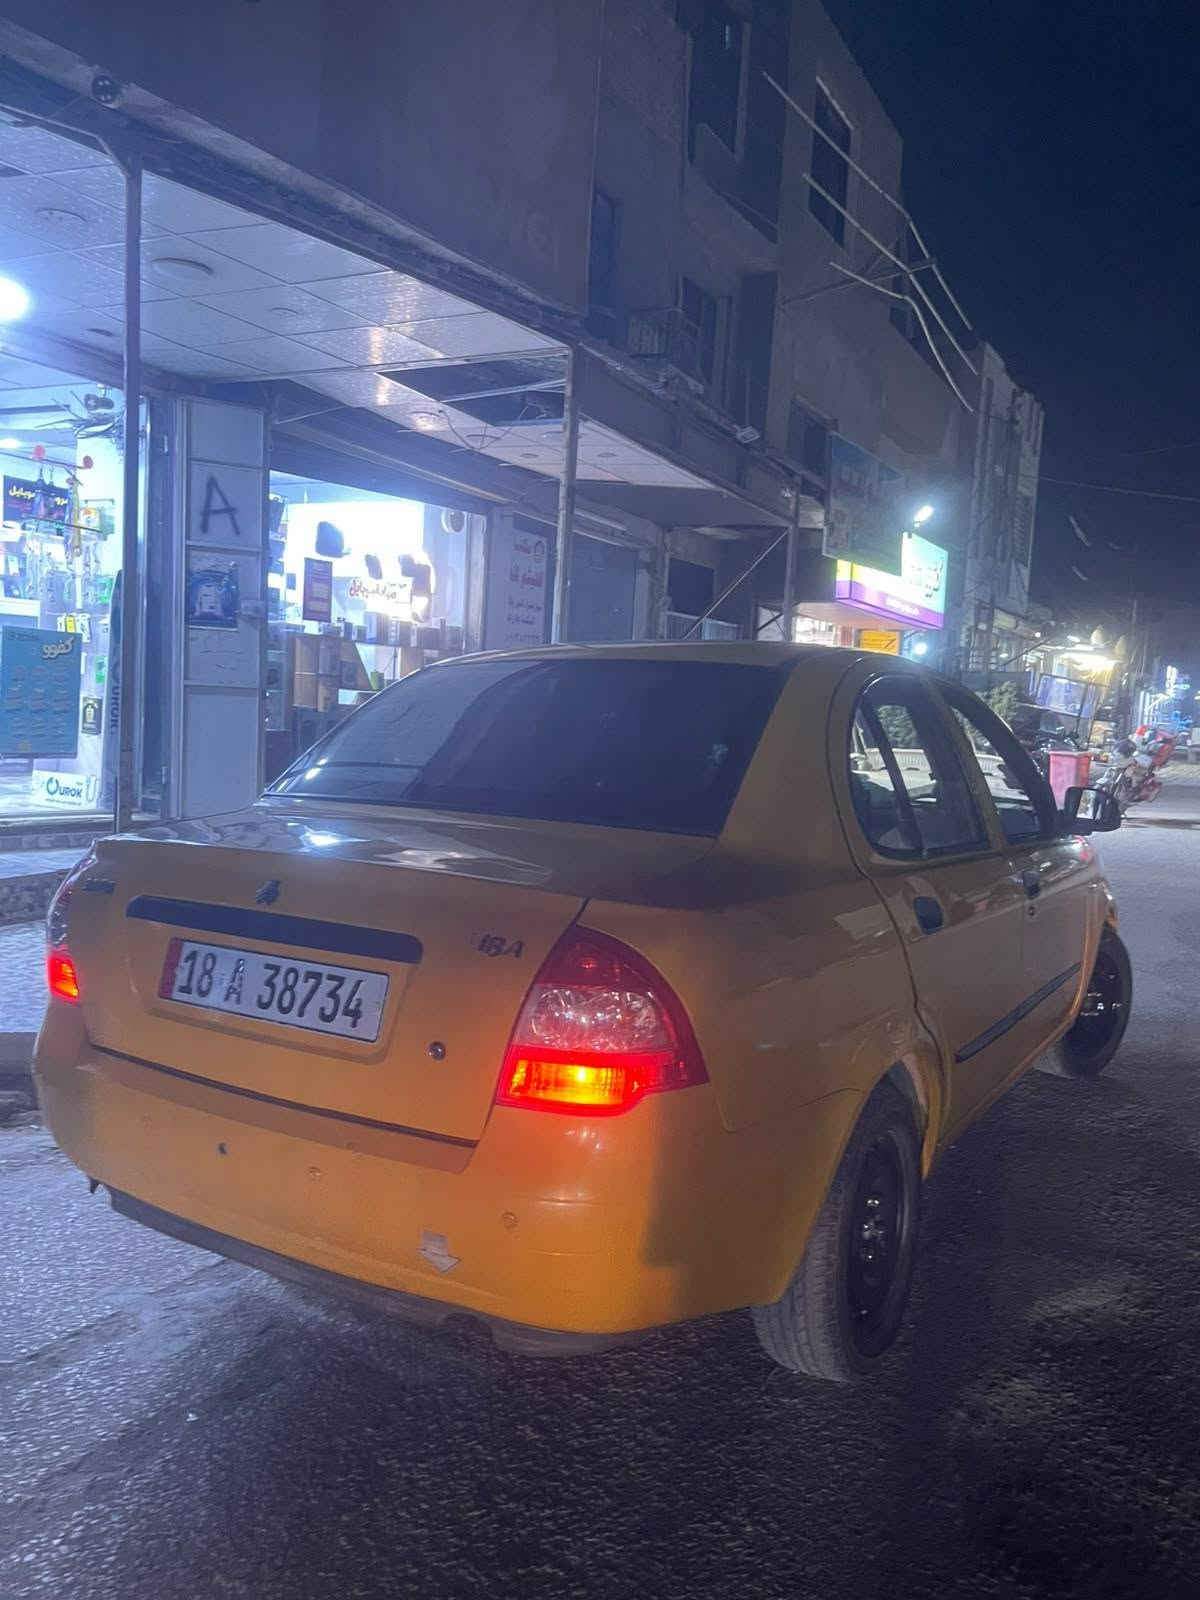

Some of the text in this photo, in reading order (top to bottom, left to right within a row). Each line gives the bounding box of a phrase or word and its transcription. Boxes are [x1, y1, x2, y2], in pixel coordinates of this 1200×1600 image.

[201, 476, 240, 535] A
[176, 950, 217, 998] 18
[256, 962, 364, 1029] 38734
